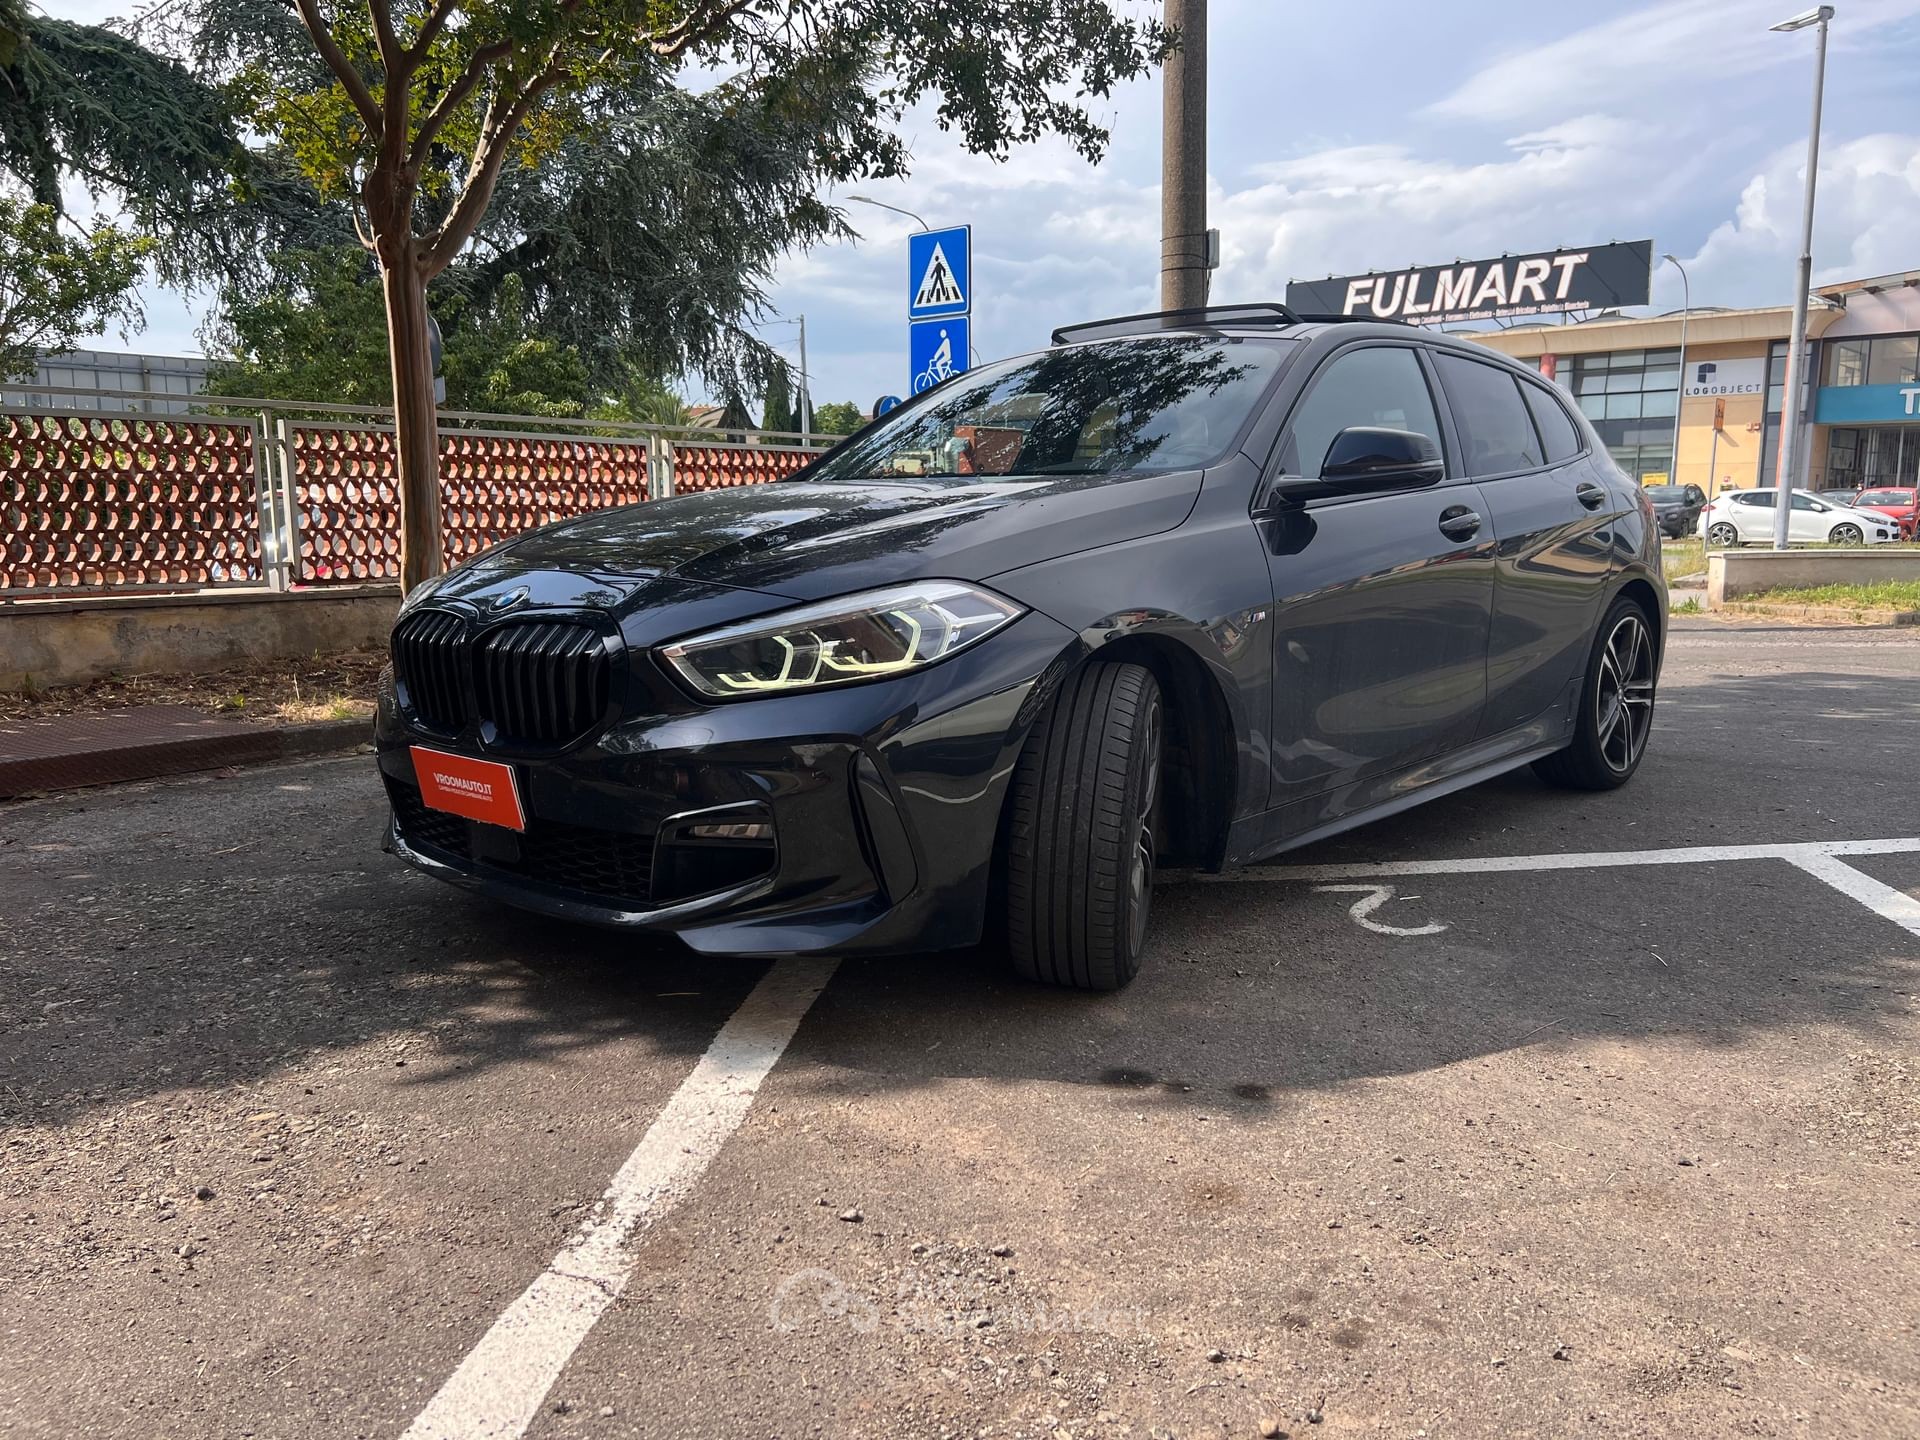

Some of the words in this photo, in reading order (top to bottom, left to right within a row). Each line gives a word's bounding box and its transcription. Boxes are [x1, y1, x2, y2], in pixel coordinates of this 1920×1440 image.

[1342, 252, 1590, 318] FULMART
[1685, 383, 1762, 396] LOGOBJECT
[433, 772, 492, 794] VROOMAUTO.IT
